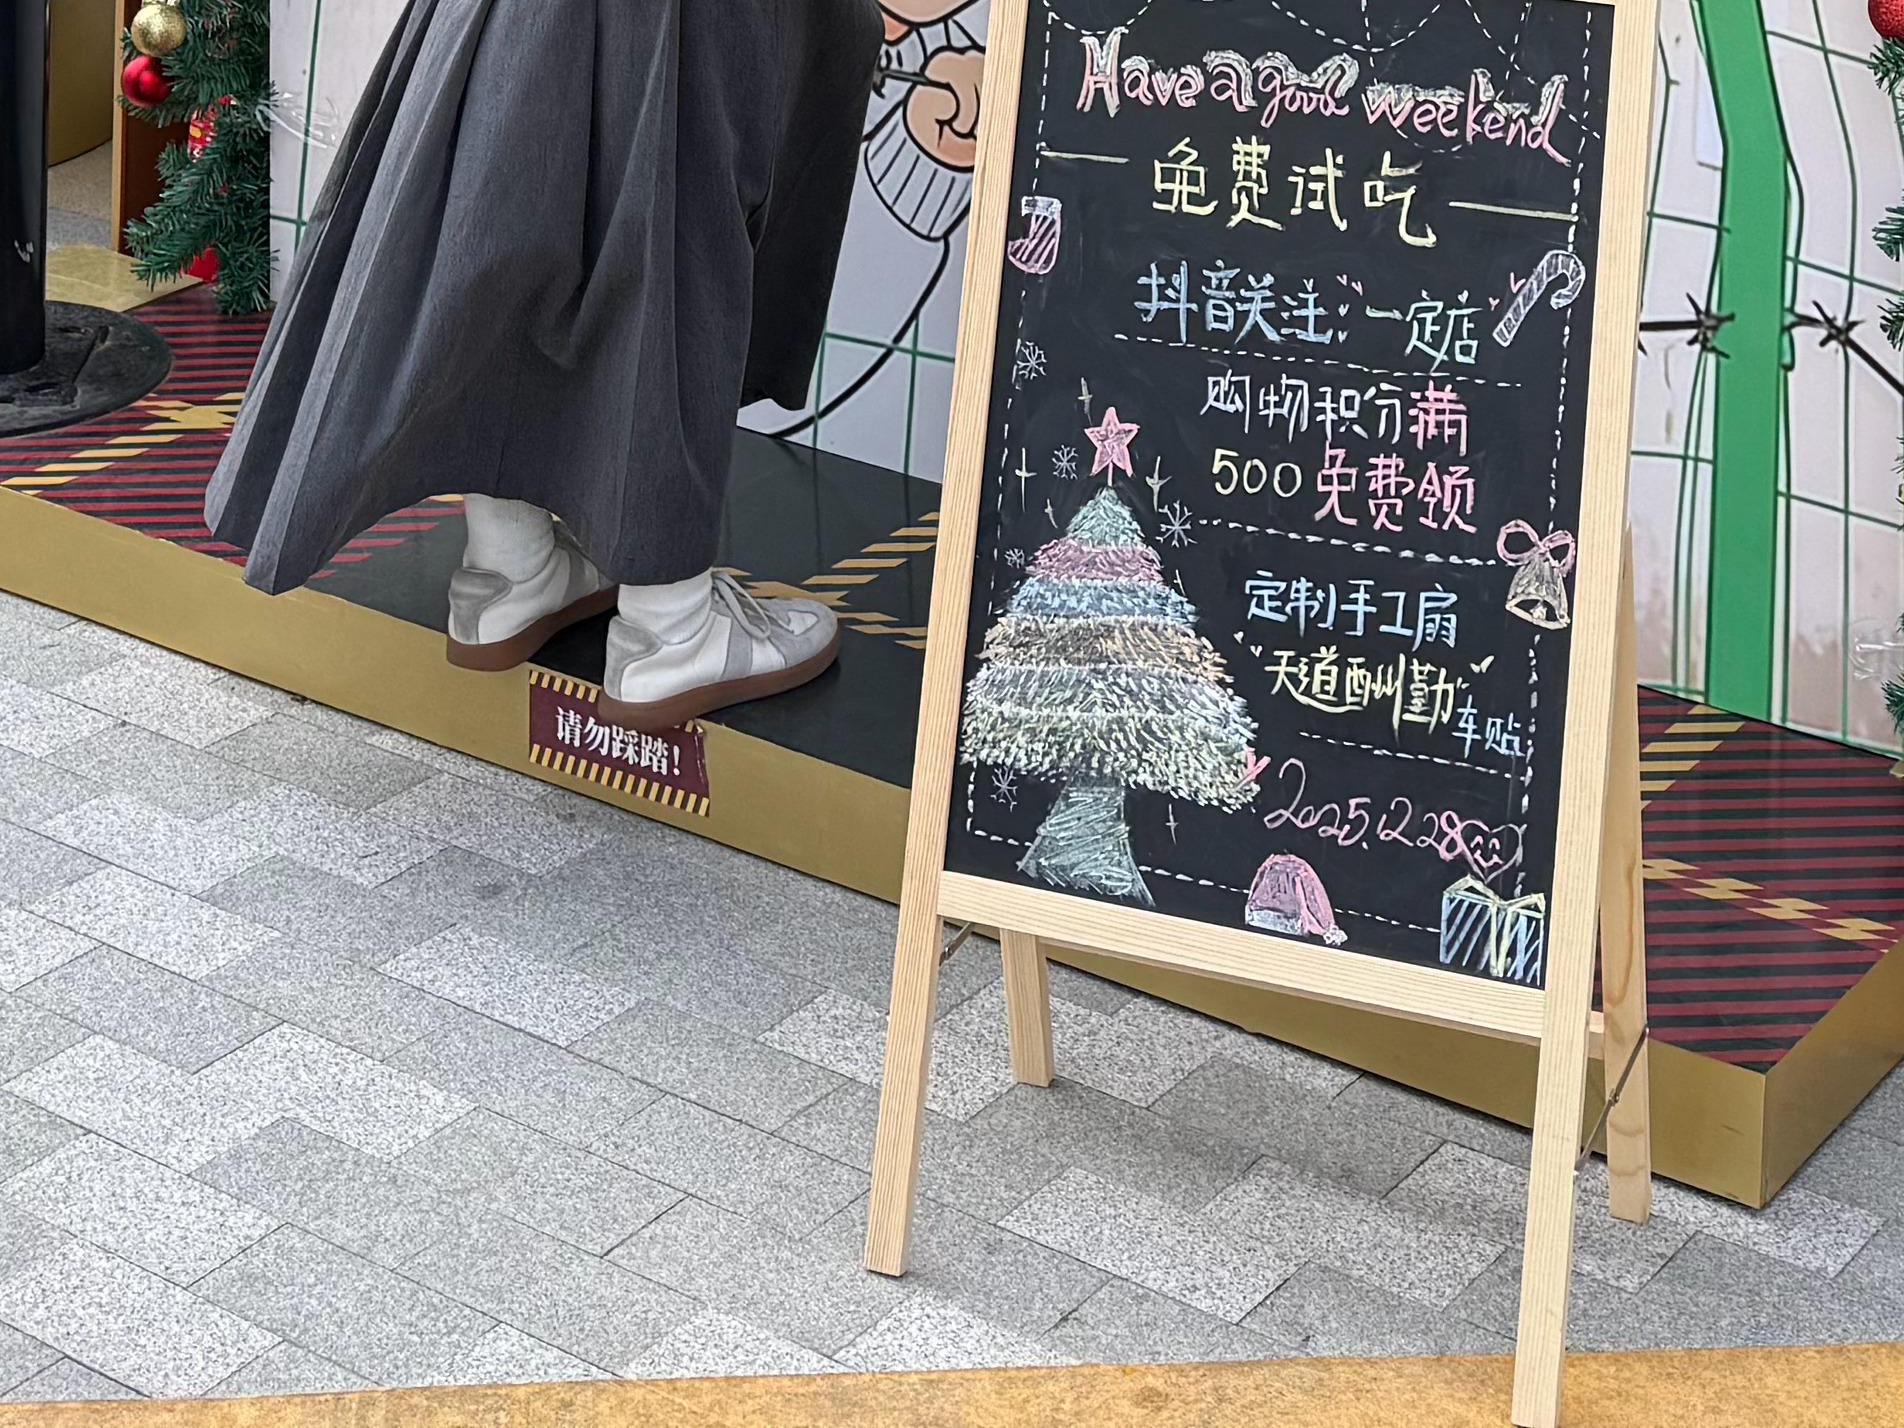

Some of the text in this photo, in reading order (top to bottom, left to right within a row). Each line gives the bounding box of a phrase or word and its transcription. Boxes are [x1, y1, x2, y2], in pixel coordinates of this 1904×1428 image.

[1077, 27, 1572, 167] Have a good weekend
[1152, 137, 1437, 247] 免费试吃
[1200, 370, 1469, 456] 购物积分满
[1245, 570, 1459, 650] 定制手工扇
[1451, 694, 1526, 759] 车贴
